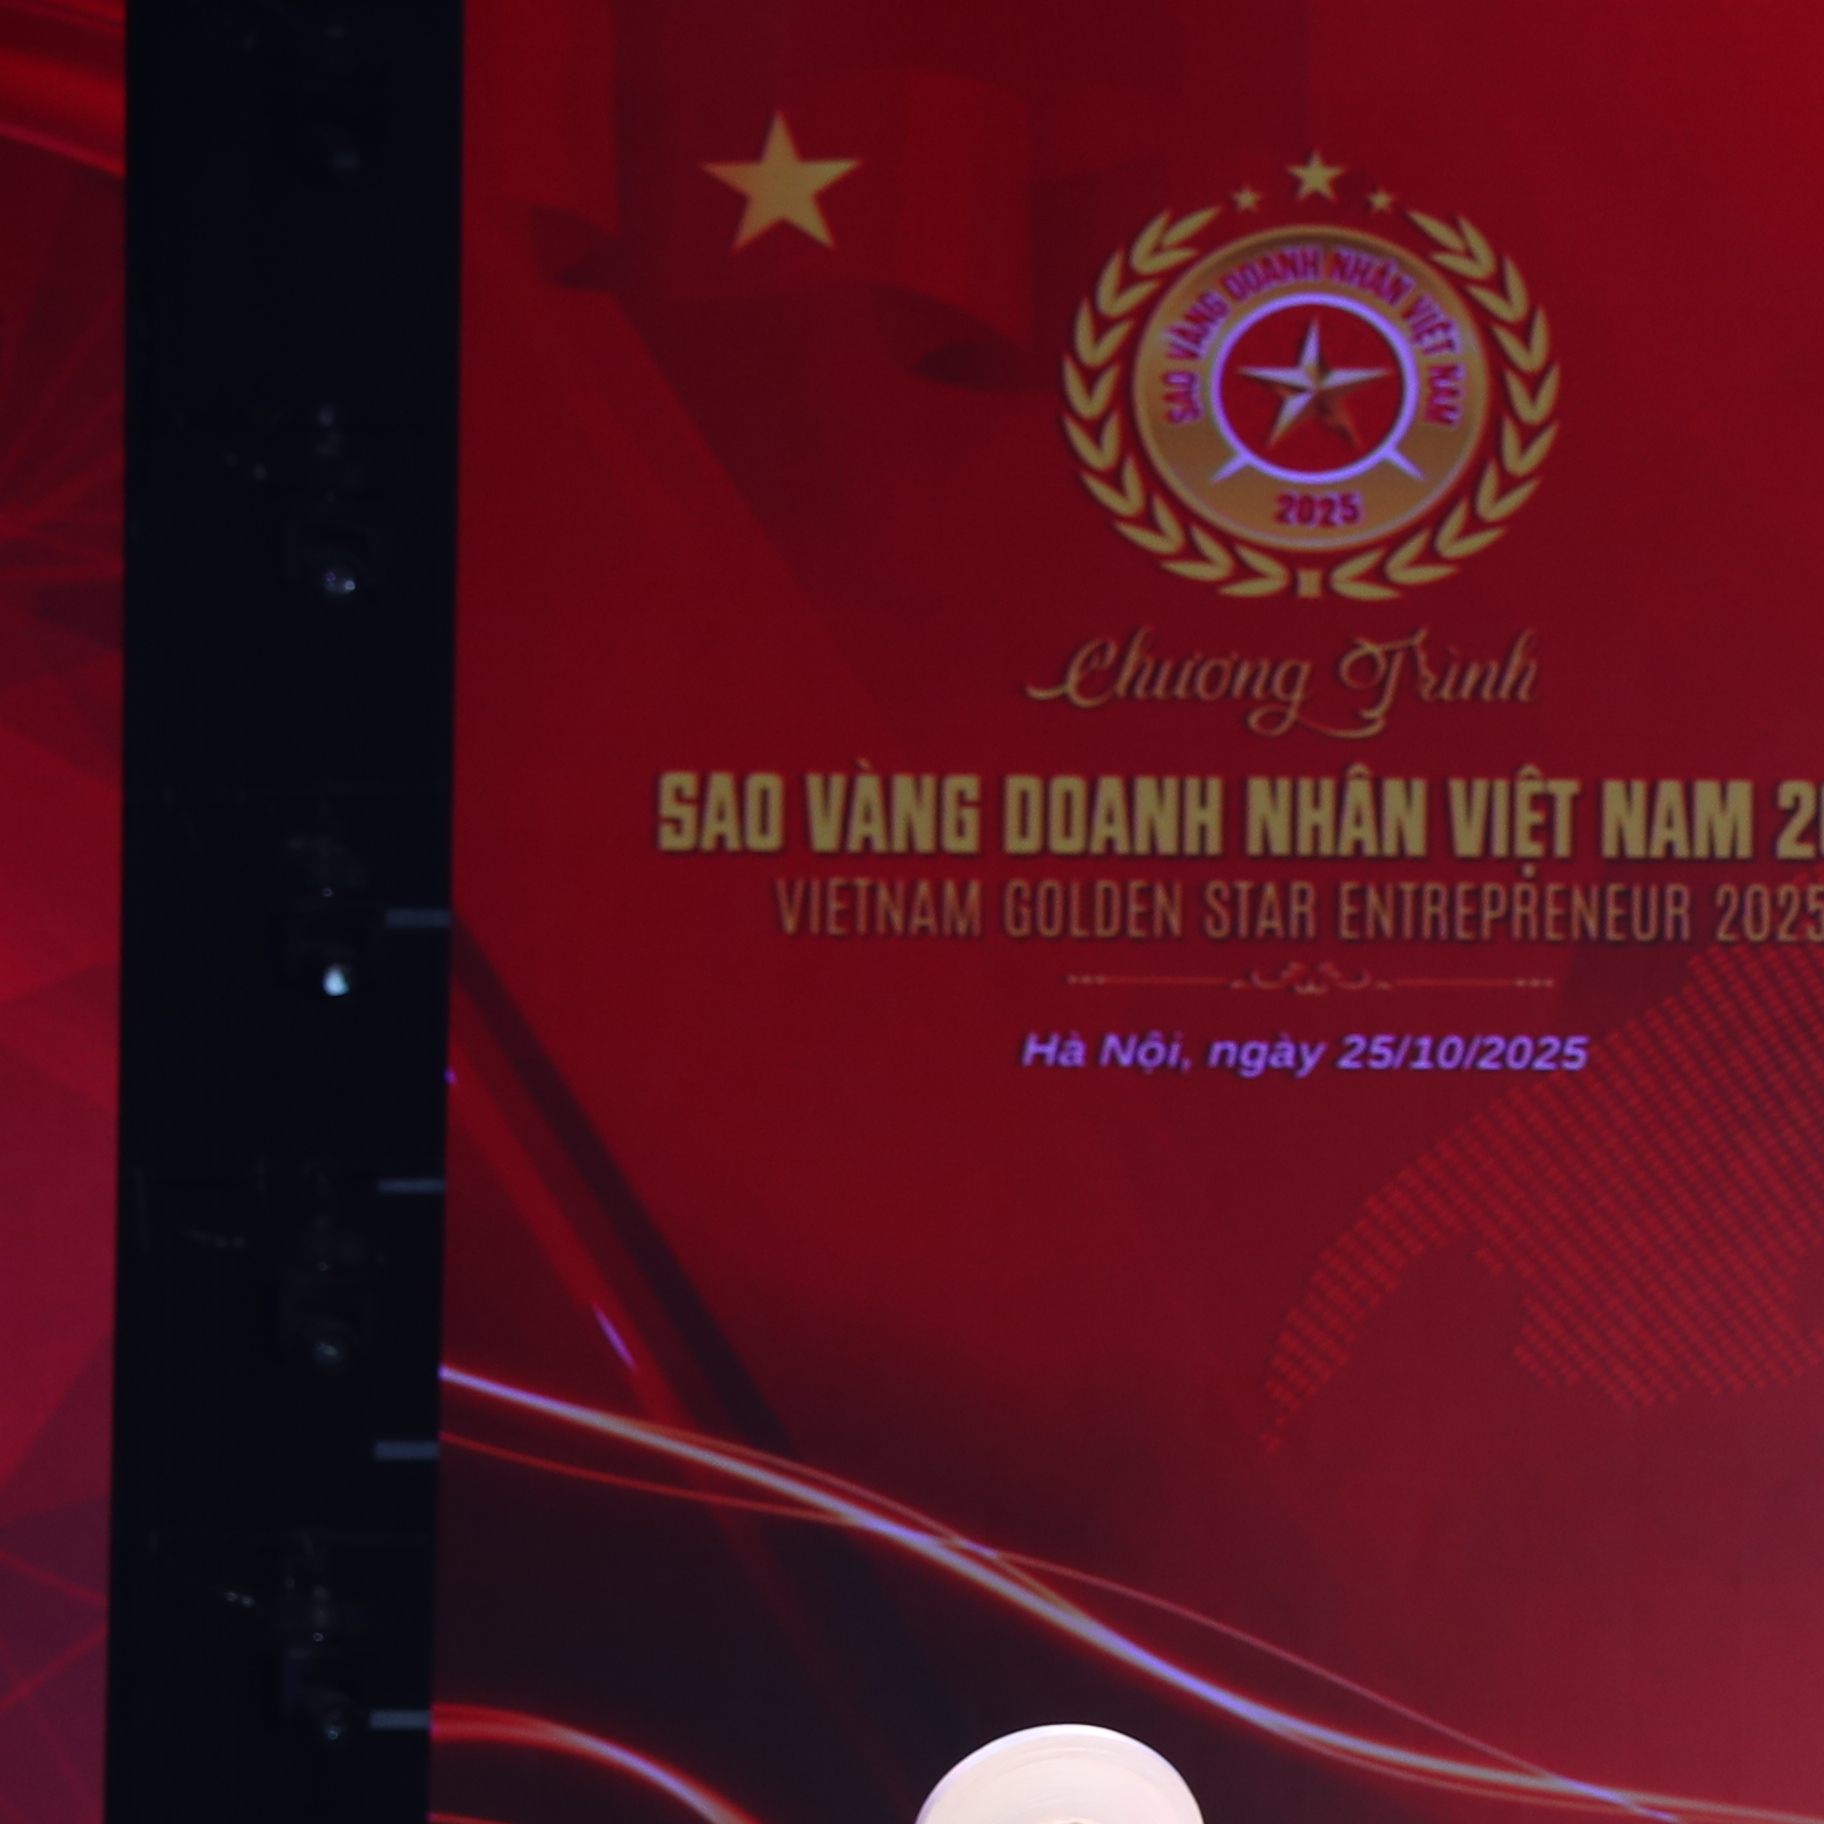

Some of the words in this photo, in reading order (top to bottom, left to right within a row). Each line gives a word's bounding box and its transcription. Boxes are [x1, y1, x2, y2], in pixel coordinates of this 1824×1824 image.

[1275, 492, 1363, 528] 2025
[1025, 623, 1312, 738] Chương
[1340, 628, 1538, 720] Trình
[658, 772, 783, 852] SAO
[805, 758, 980, 854] VÀNG
[1005, 775, 1223, 856] DOANH
[1247, 763, 1427, 857] NHÂN
[1448, 763, 1580, 878] VIỆT
[1603, 778, 1753, 859] NAM
[775, 878, 982, 936] VIETNAM
[1005, 880, 1182, 938] GOLDEN
[1204, 880, 1315, 940] STAR
[1339, 882, 1691, 941] ENTREPRENEUR
[1022, 1031, 1086, 1067] Hà
[1100, 1031, 1192, 1075] Nội,
[1207, 1031, 1327, 1078] ngày
[1336, 1033, 1590, 1071] 25/10/2025
